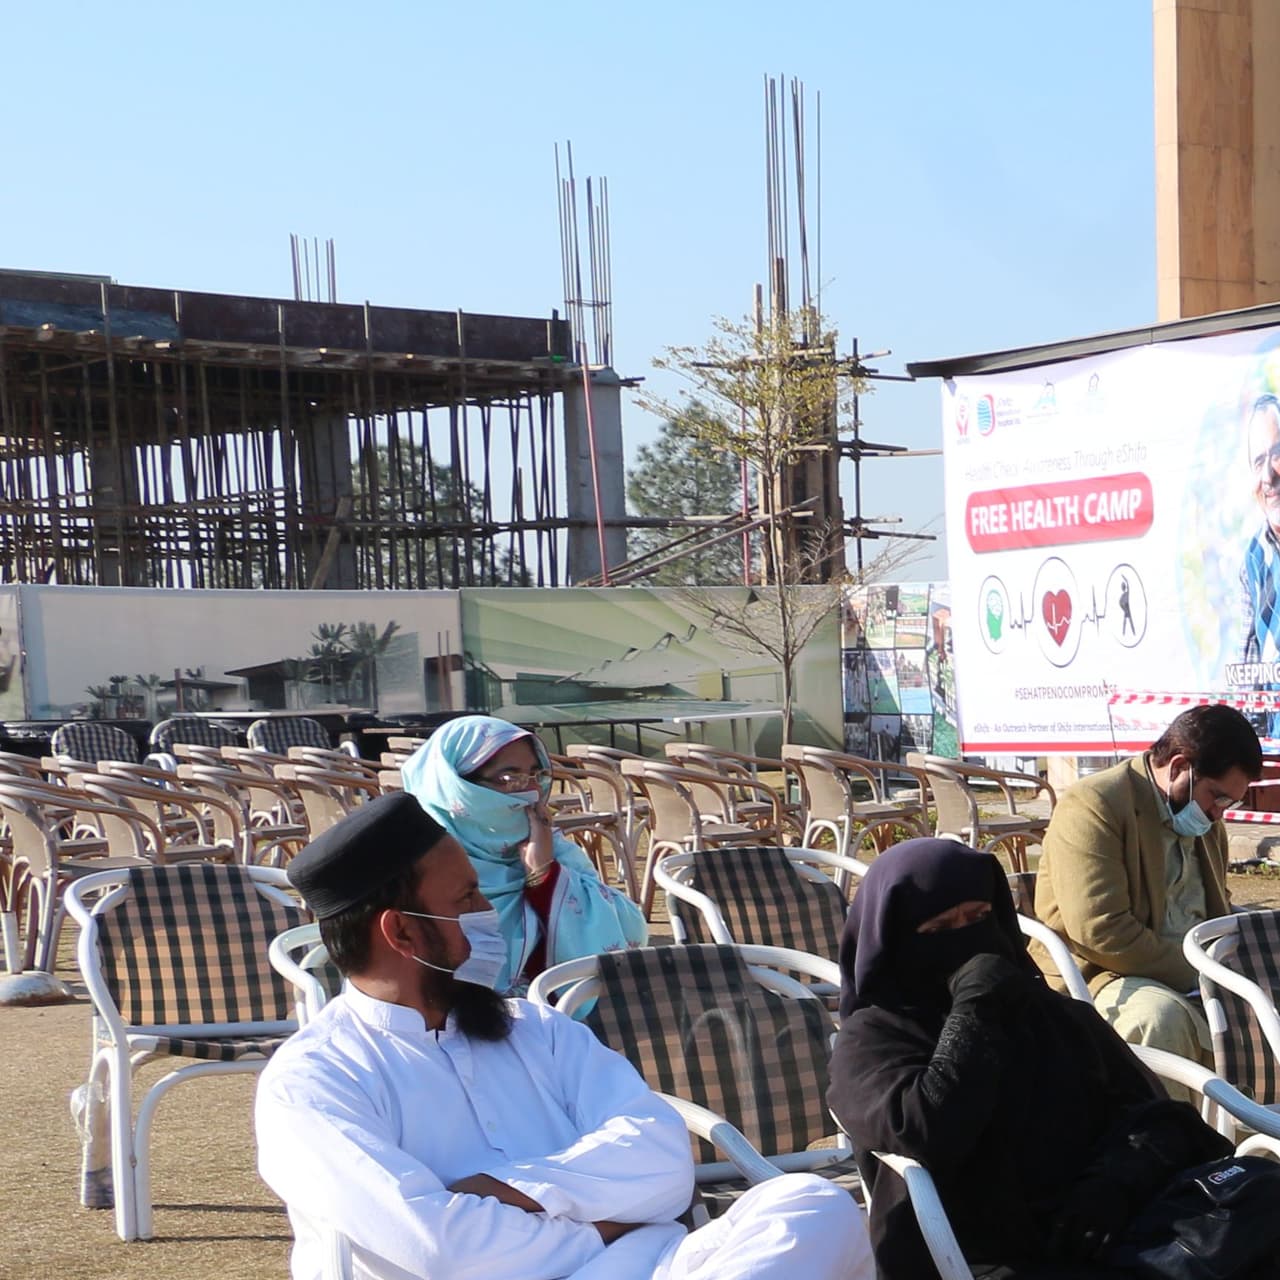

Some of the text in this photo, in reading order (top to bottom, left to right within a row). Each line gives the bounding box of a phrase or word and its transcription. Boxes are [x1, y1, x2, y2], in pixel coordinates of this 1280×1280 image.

[1074, 446, 1113, 471] Through
[970, 488, 1142, 536] FREE HEALTH CAMP
